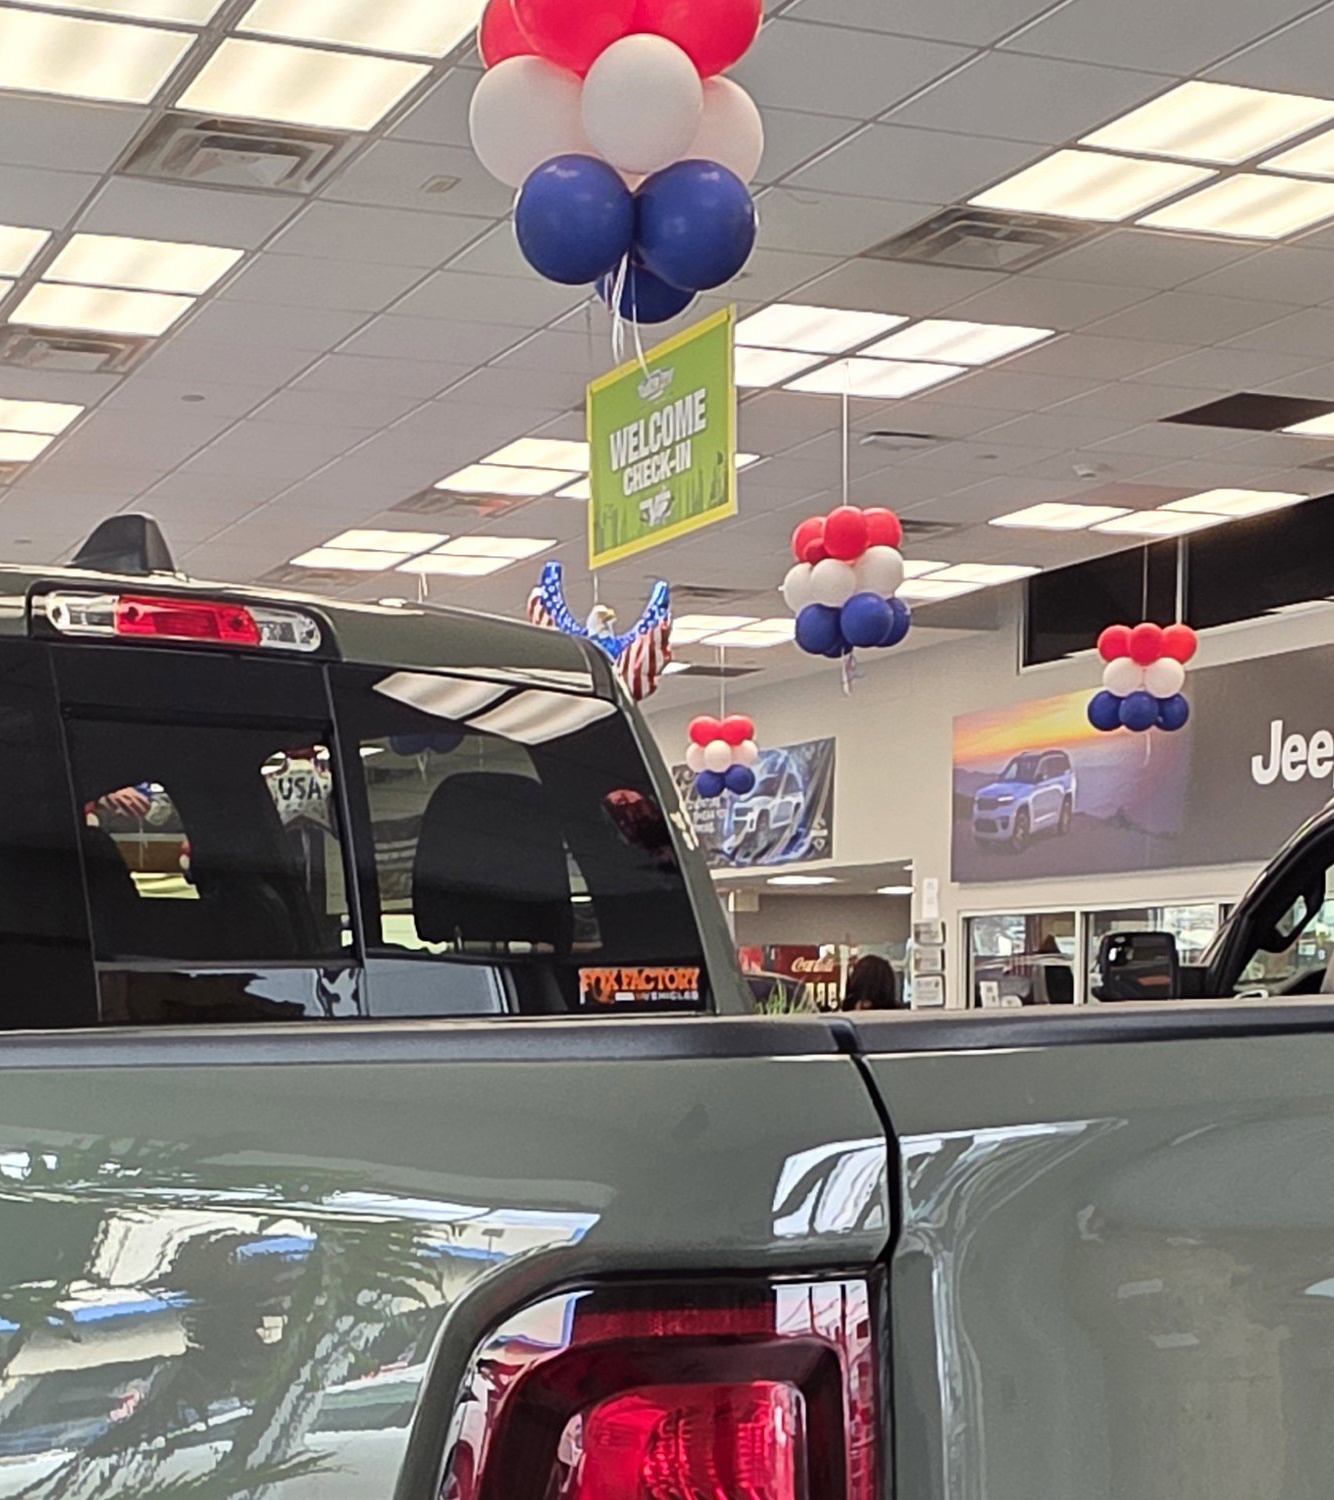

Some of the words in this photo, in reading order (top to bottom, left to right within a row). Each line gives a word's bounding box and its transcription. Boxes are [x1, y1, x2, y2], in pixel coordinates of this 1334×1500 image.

[609, 387, 707, 472] WELCOME
[623, 439, 691, 496] CHECK-IN
[278, 776, 322, 801] USA
[579, 966, 620, 1005] FOX
[620, 966, 700, 992] FACTORY
